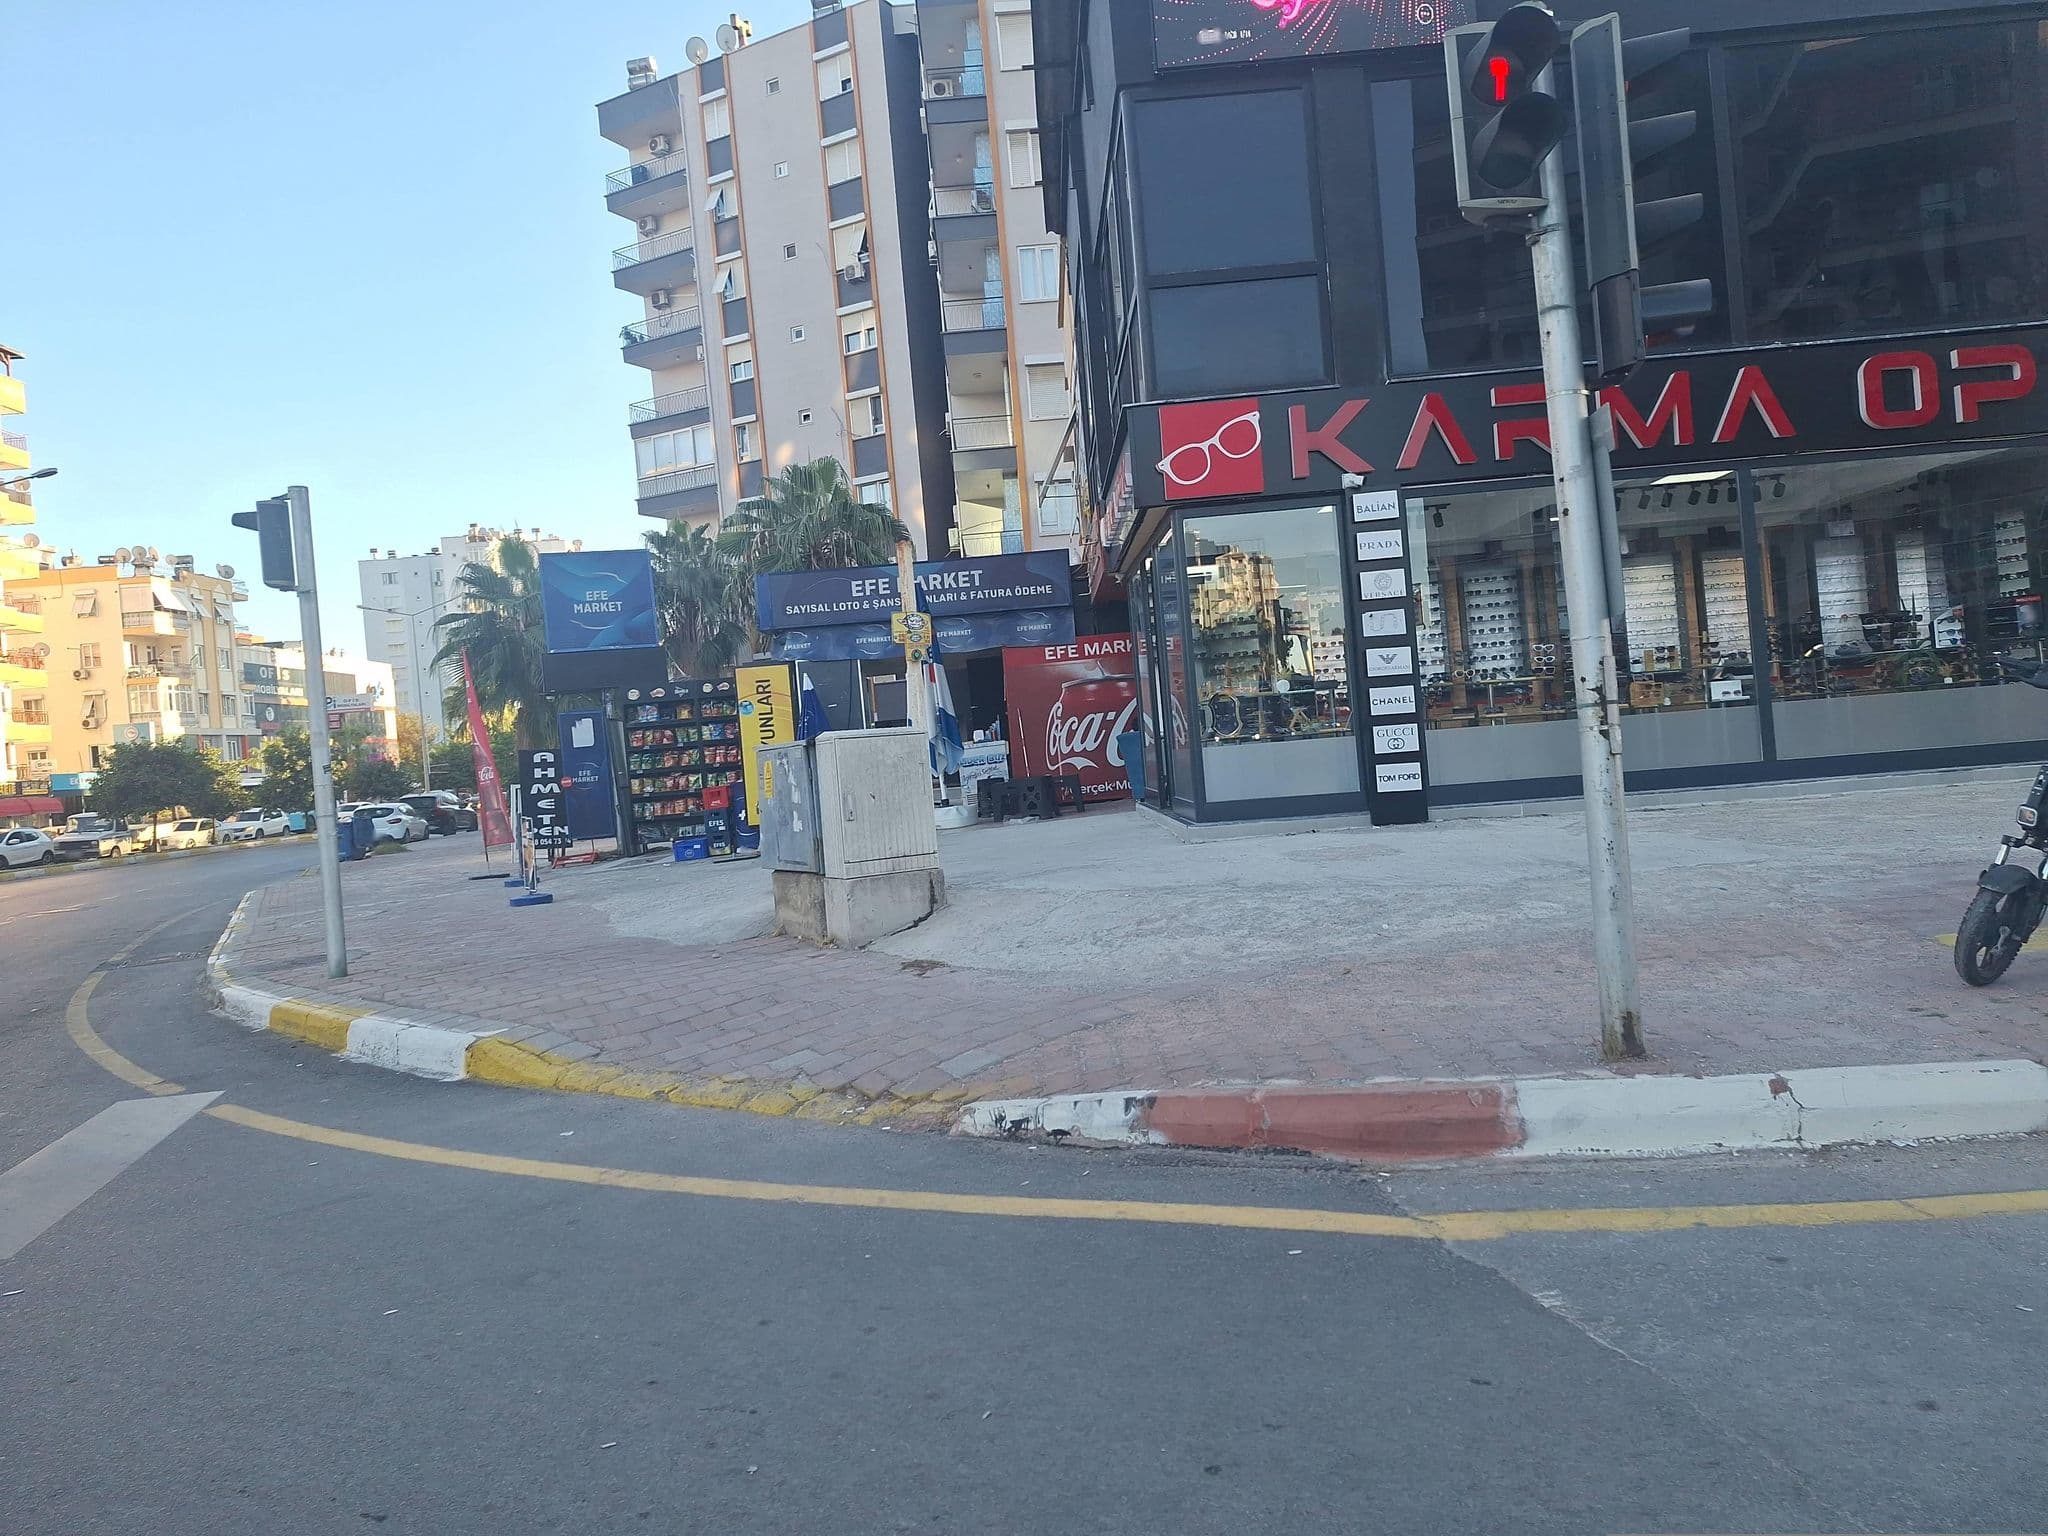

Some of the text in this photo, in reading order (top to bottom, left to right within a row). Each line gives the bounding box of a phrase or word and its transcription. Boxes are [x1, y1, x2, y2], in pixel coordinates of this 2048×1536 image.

[1288, 343, 2038, 479] KARMA OP
[1359, 540, 1401, 551] PRADA
[851, 570, 983, 597] EFE ARKET
[586, 590, 609, 601] EFE
[785, 584, 1053, 615] SAYISAL LOTO & ŞANS NLARI & FATURA ÖDEME
[573, 601, 623, 614] MARKET
[949, 629, 972, 637] MARKET
[1029, 623, 1052, 631] MARKET
[1045, 644, 1079, 660] EFE
[1084, 639, 1133, 657] MARK
[1371, 696, 1414, 706] CHANEL
[755, 679, 776, 745] UNLARI
[1376, 727, 1415, 738] GUCCI
[572, 775, 599, 783] MARKET
[1378, 773, 1420, 783] TOM FORD
[530, 752, 561, 825] AHMET
[1080, 781, 1113, 796] erçek
